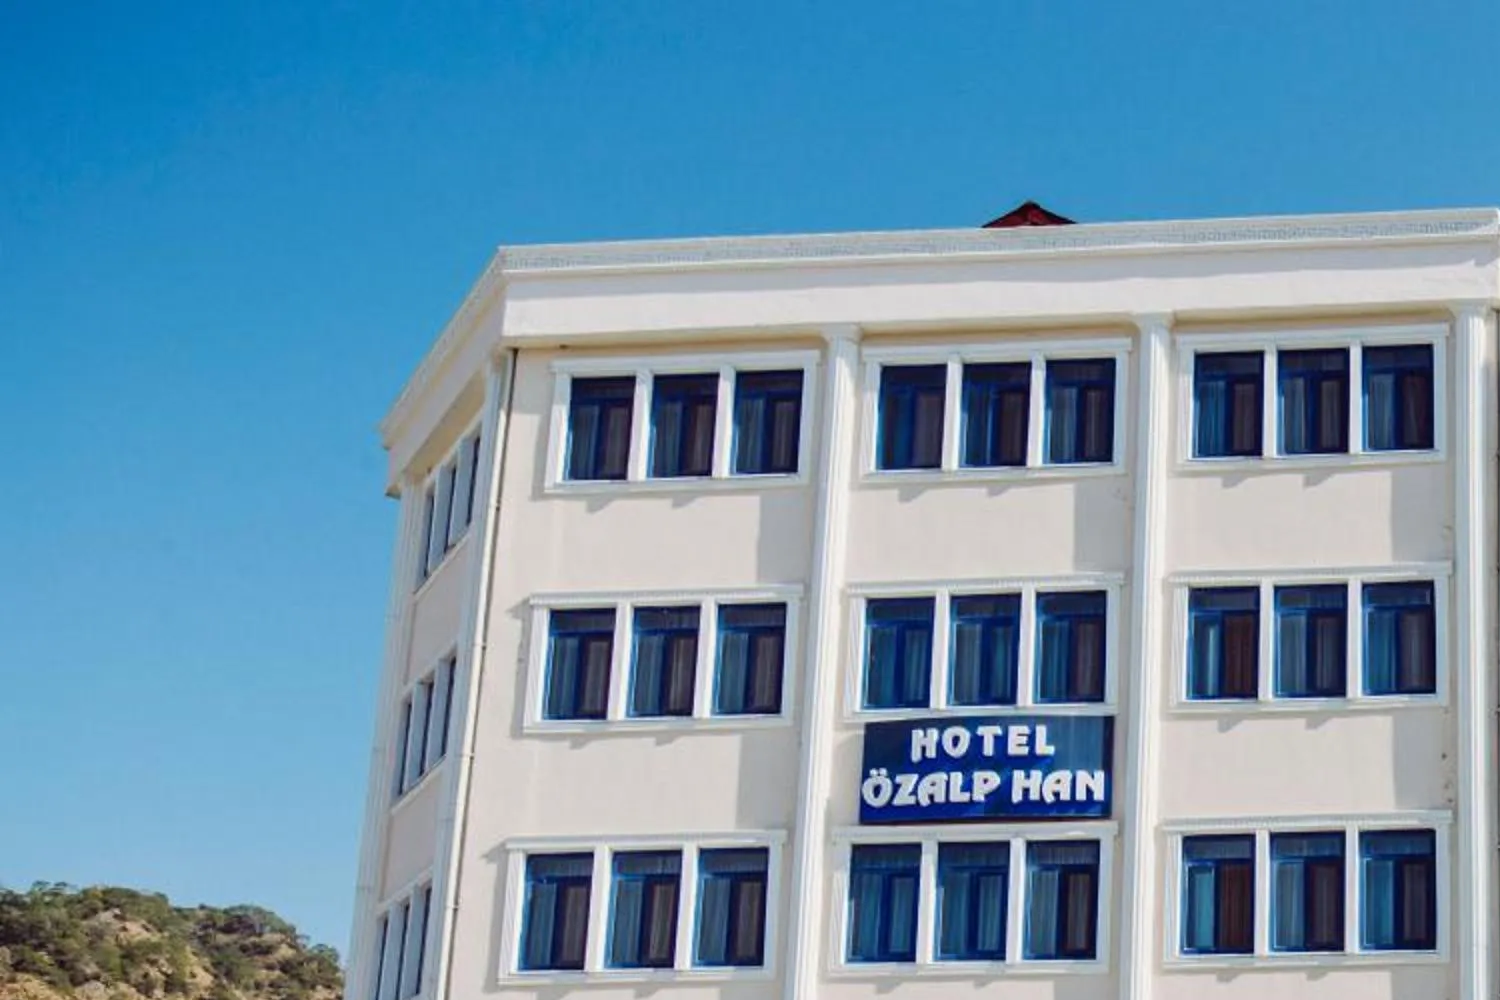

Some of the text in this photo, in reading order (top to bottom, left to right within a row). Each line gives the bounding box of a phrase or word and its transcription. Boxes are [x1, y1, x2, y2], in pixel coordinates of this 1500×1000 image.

[911, 724, 1055, 763] HOTEL
[861, 768, 1105, 808] ÖZALP HAN
